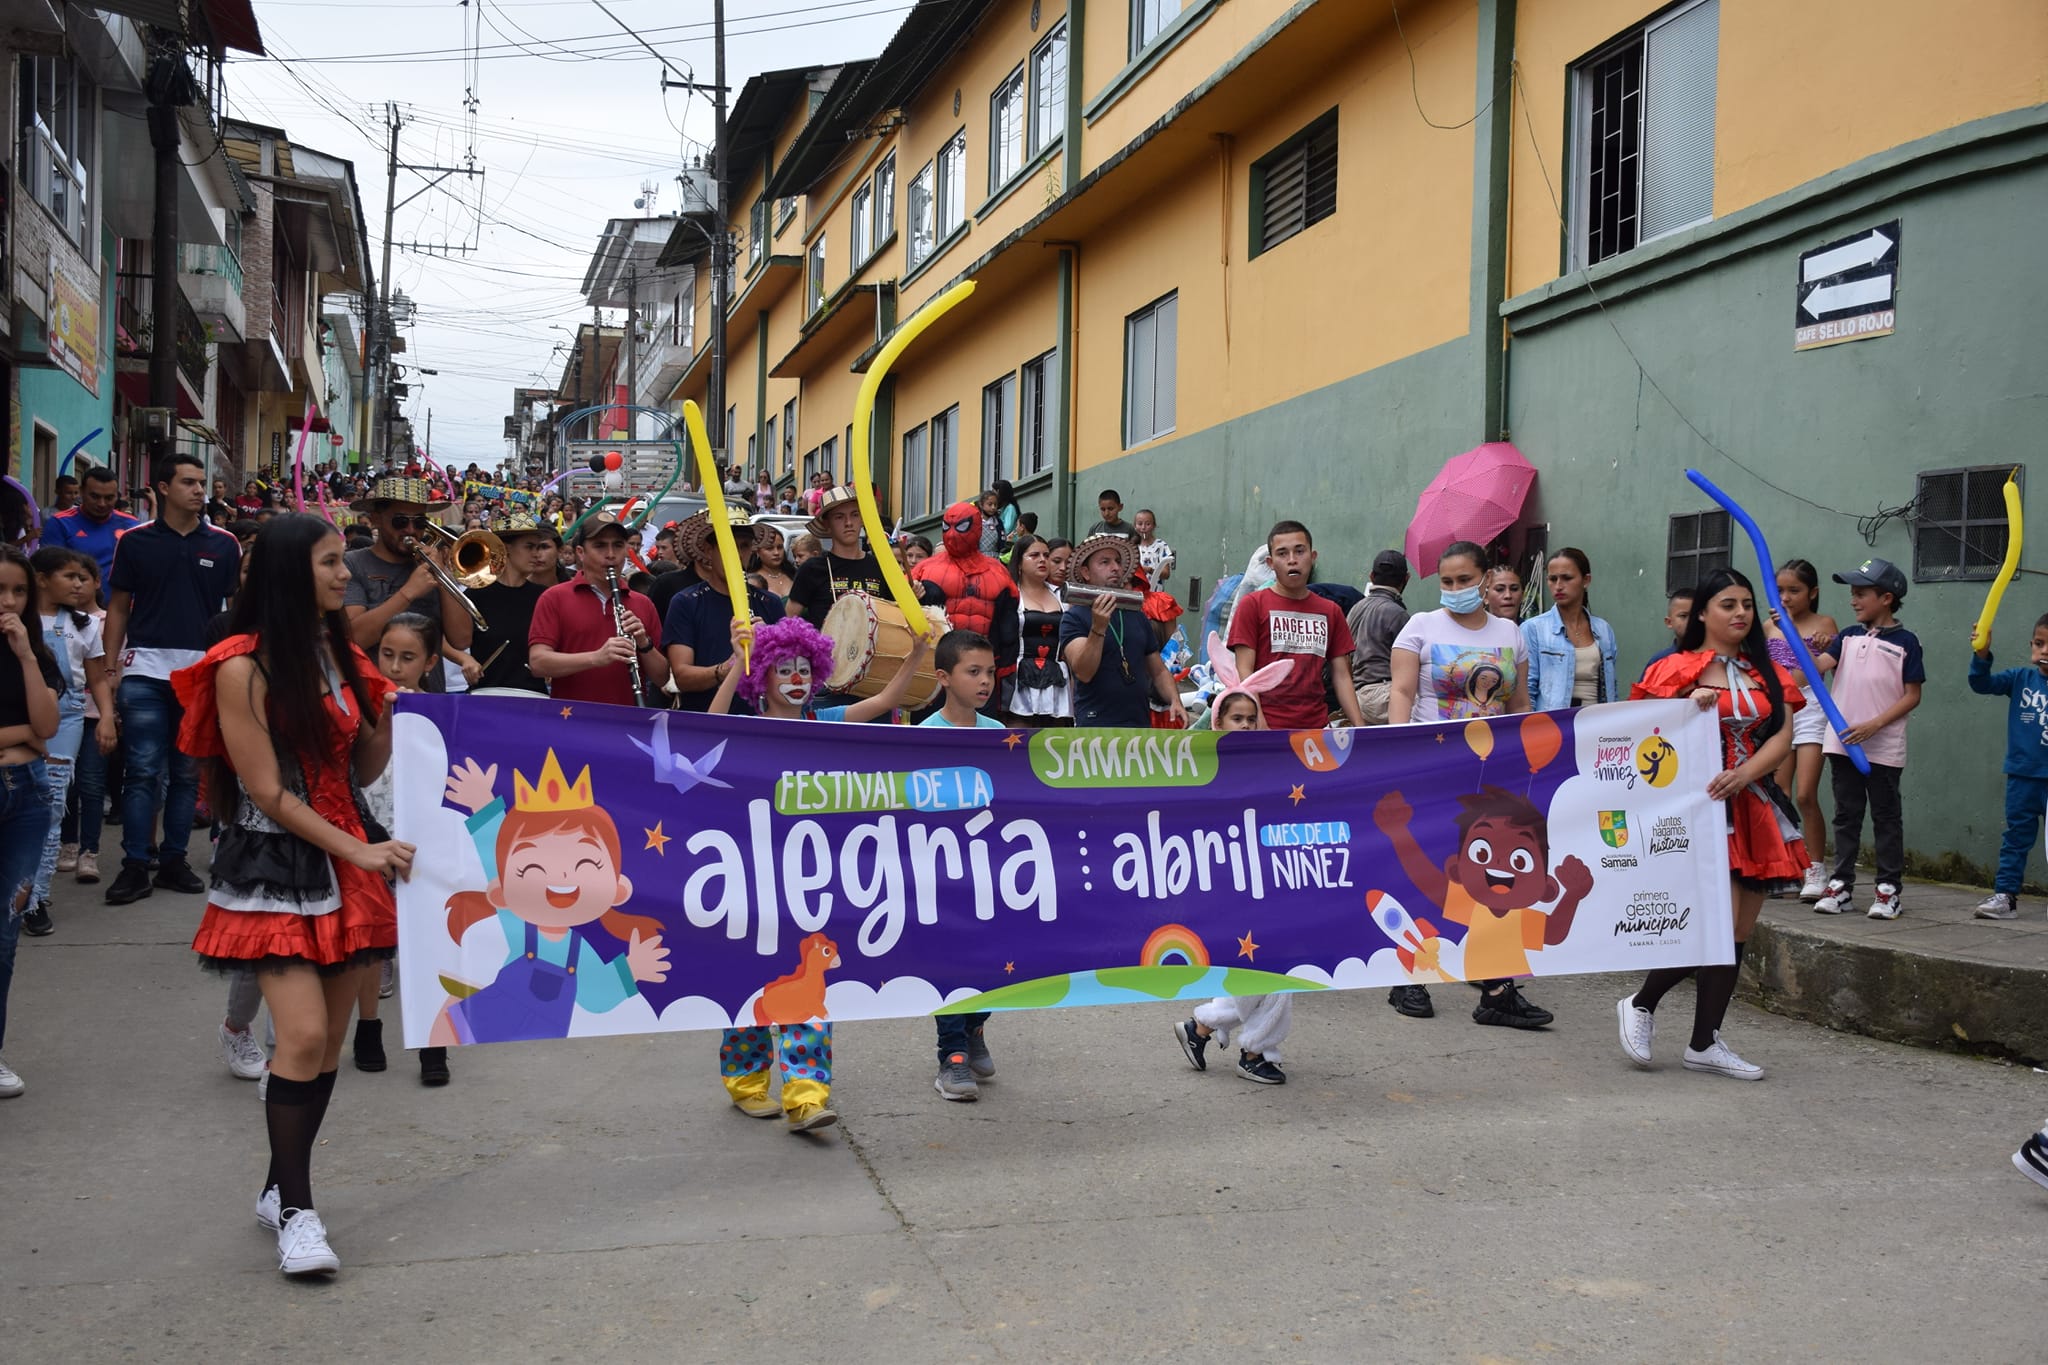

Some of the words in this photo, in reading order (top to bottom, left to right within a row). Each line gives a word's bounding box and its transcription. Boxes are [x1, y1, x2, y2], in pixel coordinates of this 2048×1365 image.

[1797, 329, 1816, 343] CAFE
[1819, 320, 1855, 340] SELLO
[1859, 312, 1894, 332] ROJO
[1273, 616, 1326, 637] ANGELES
[1273, 632, 1295, 641] GREAT
[1296, 634, 1325, 645] SUMMER
[1303, 738, 1324, 767] A
[1594, 742, 1634, 768] juego
[1598, 763, 1637, 790] niñez
[780, 770, 904, 810] FESTIVAL
[912, 771, 946, 808] DE
[955, 771, 990, 808] LA
[1268, 824, 1300, 847] MES
[1305, 822, 1325, 845] DE
[1328, 821, 1349, 845] LA
[1652, 826, 1686, 839] hagamos
[1656, 815, 1681, 827] Juntos
[1111, 808, 1265, 899] abril
[1649, 837, 1689, 855] historia
[1271, 845, 1353, 889] NIÑEZ
[1600, 856, 1638, 869] Samaná
[683, 798, 1058, 958] alegría
[1633, 890, 1669, 902] primera
[1614, 907, 1690, 936] municipal
[1625, 902, 1677, 920] gestora
